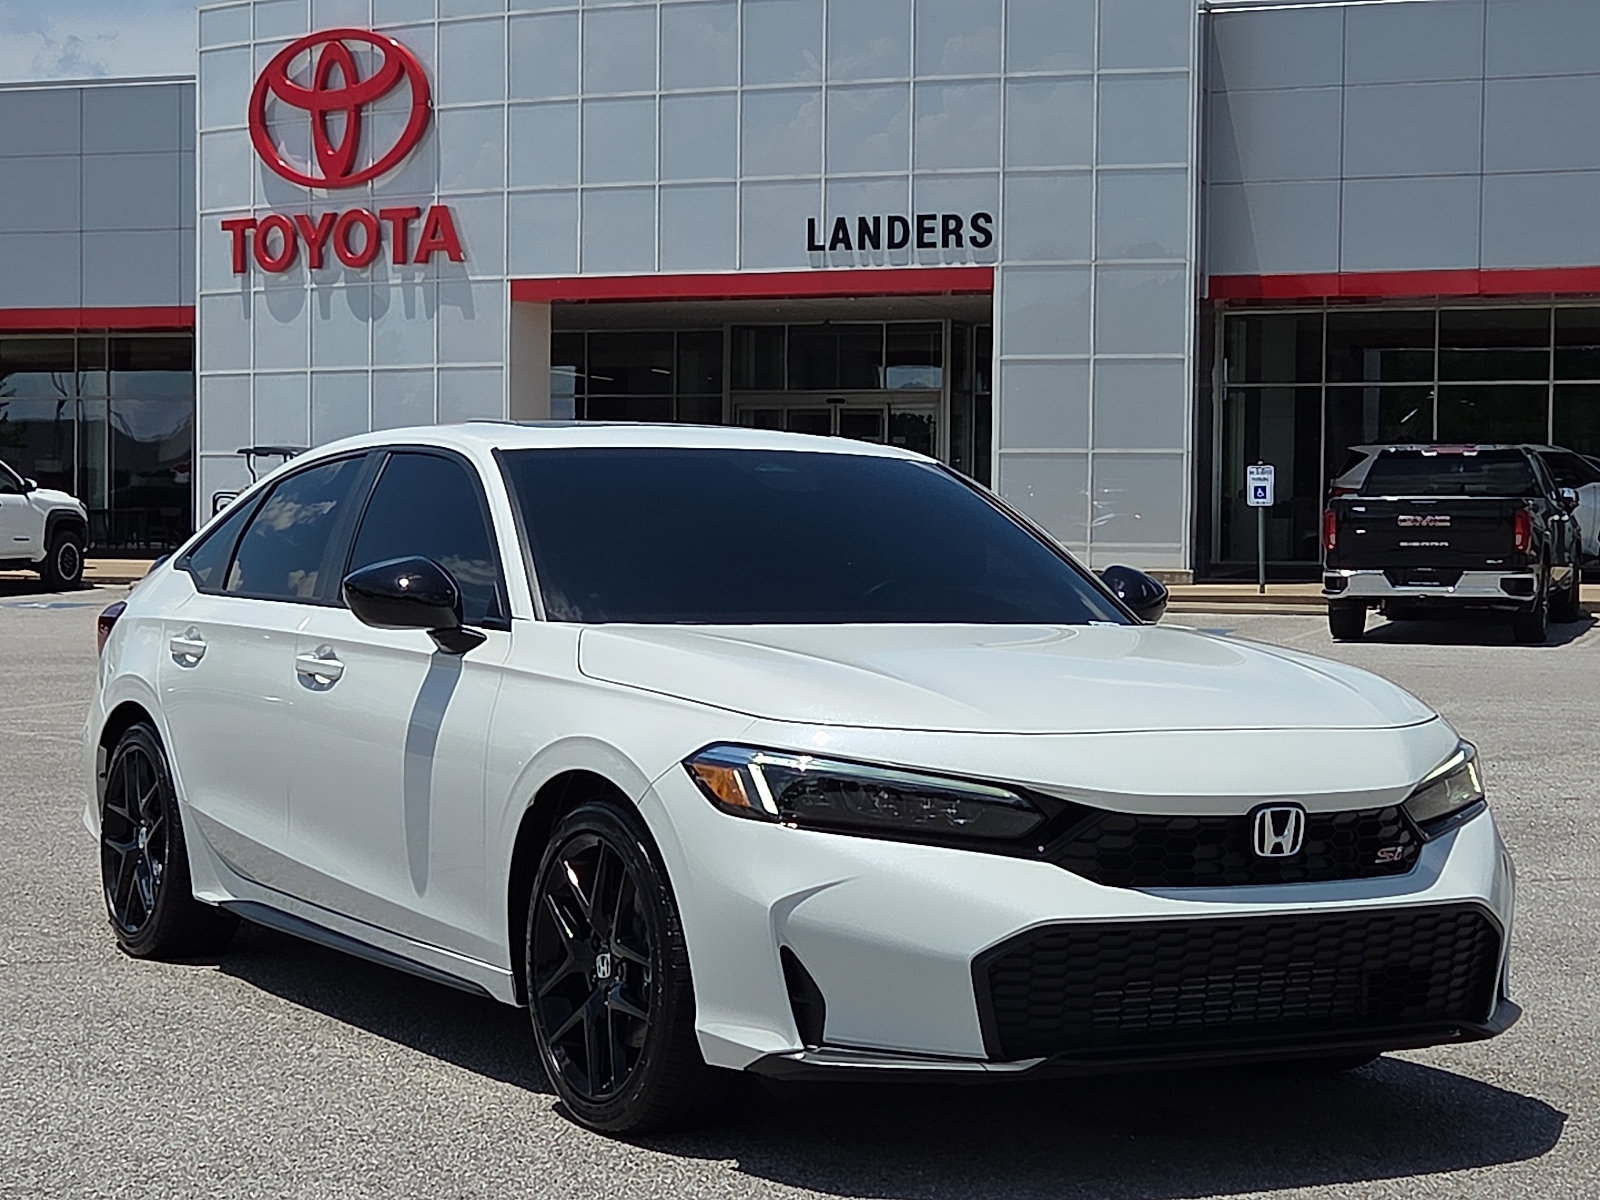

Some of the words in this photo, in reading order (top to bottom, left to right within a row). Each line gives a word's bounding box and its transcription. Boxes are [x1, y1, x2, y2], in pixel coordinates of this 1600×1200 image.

[221, 205, 465, 274] TOYOTA
[807, 212, 993, 251] LANDERS
[1397, 515, 1451, 527] GMC
